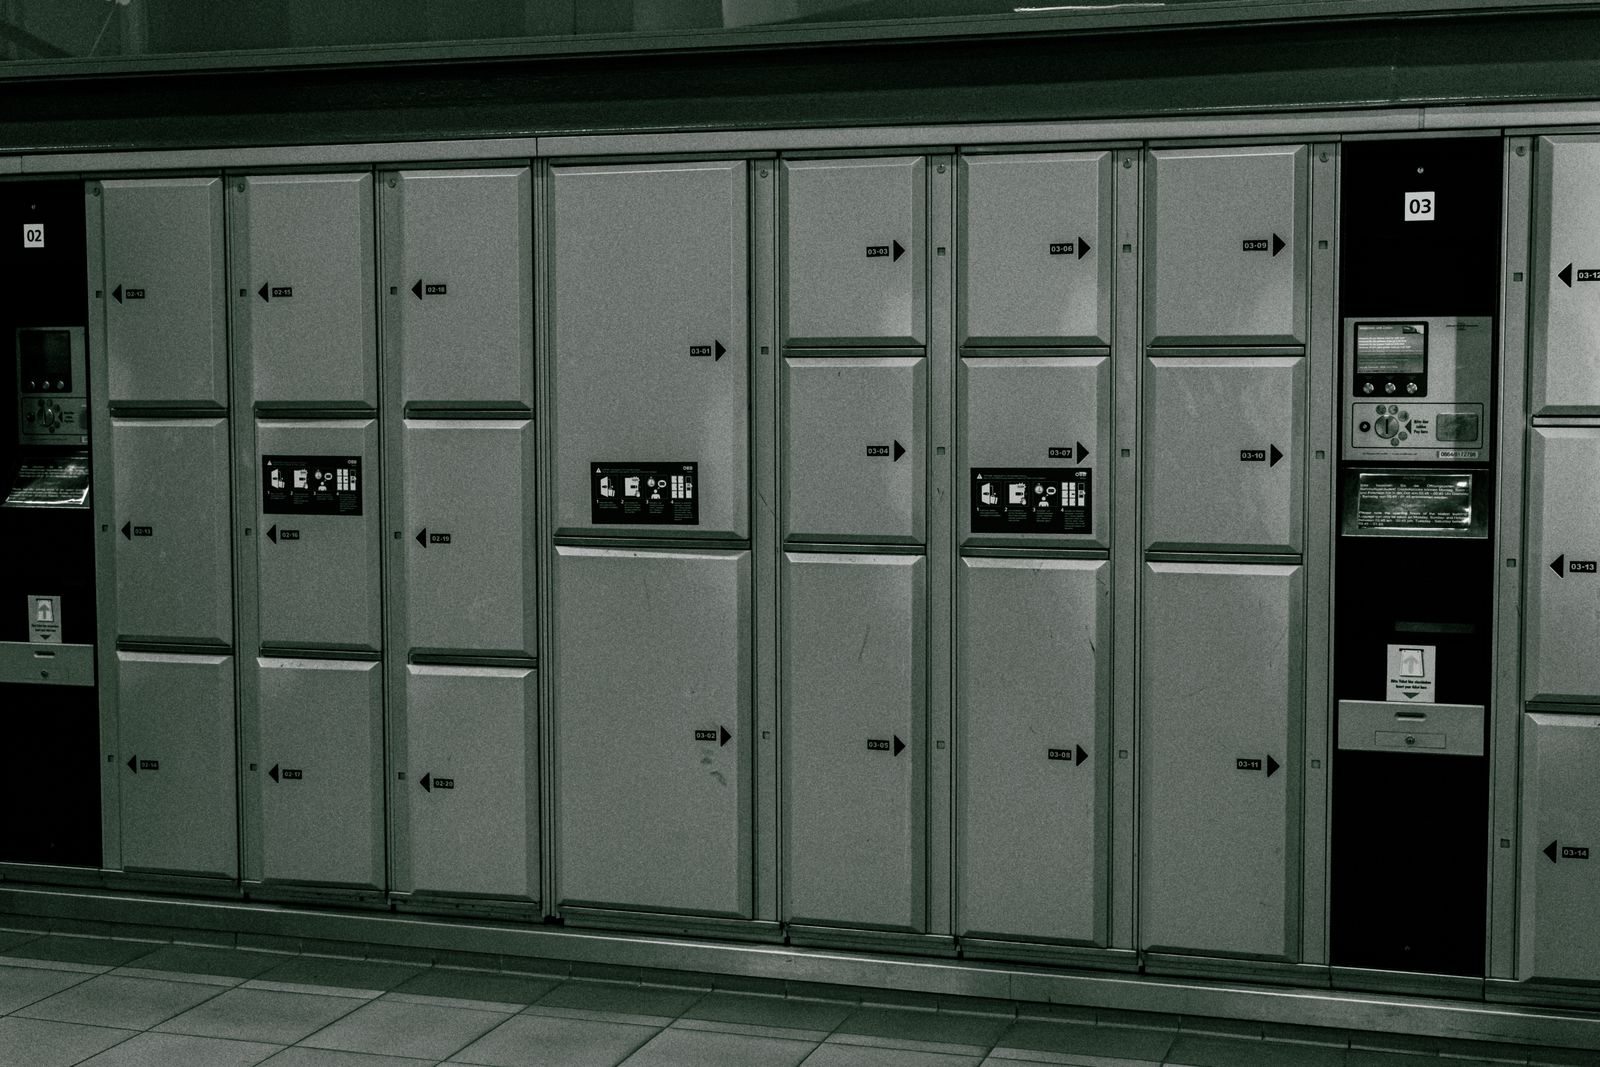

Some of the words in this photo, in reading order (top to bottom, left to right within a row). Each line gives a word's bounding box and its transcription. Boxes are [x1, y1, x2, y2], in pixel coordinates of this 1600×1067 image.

[1409, 198, 1432, 214] 03
[27, 229, 42, 243] 02
[1051, 245, 1073, 253] 03-06
[1578, 271, 1600, 279] 03-12
[867, 447, 889, 455] 03-04
[1241, 452, 1264, 460] 03-10
[1570, 563, 1595, 571] 03-13
[868, 741, 889, 749] 03-05
[1049, 751, 1071, 759] 03-08
[1238, 760, 1259, 768] 03-11
[435, 780, 453, 788] 02-20
[1563, 849, 1587, 857] 03-14
